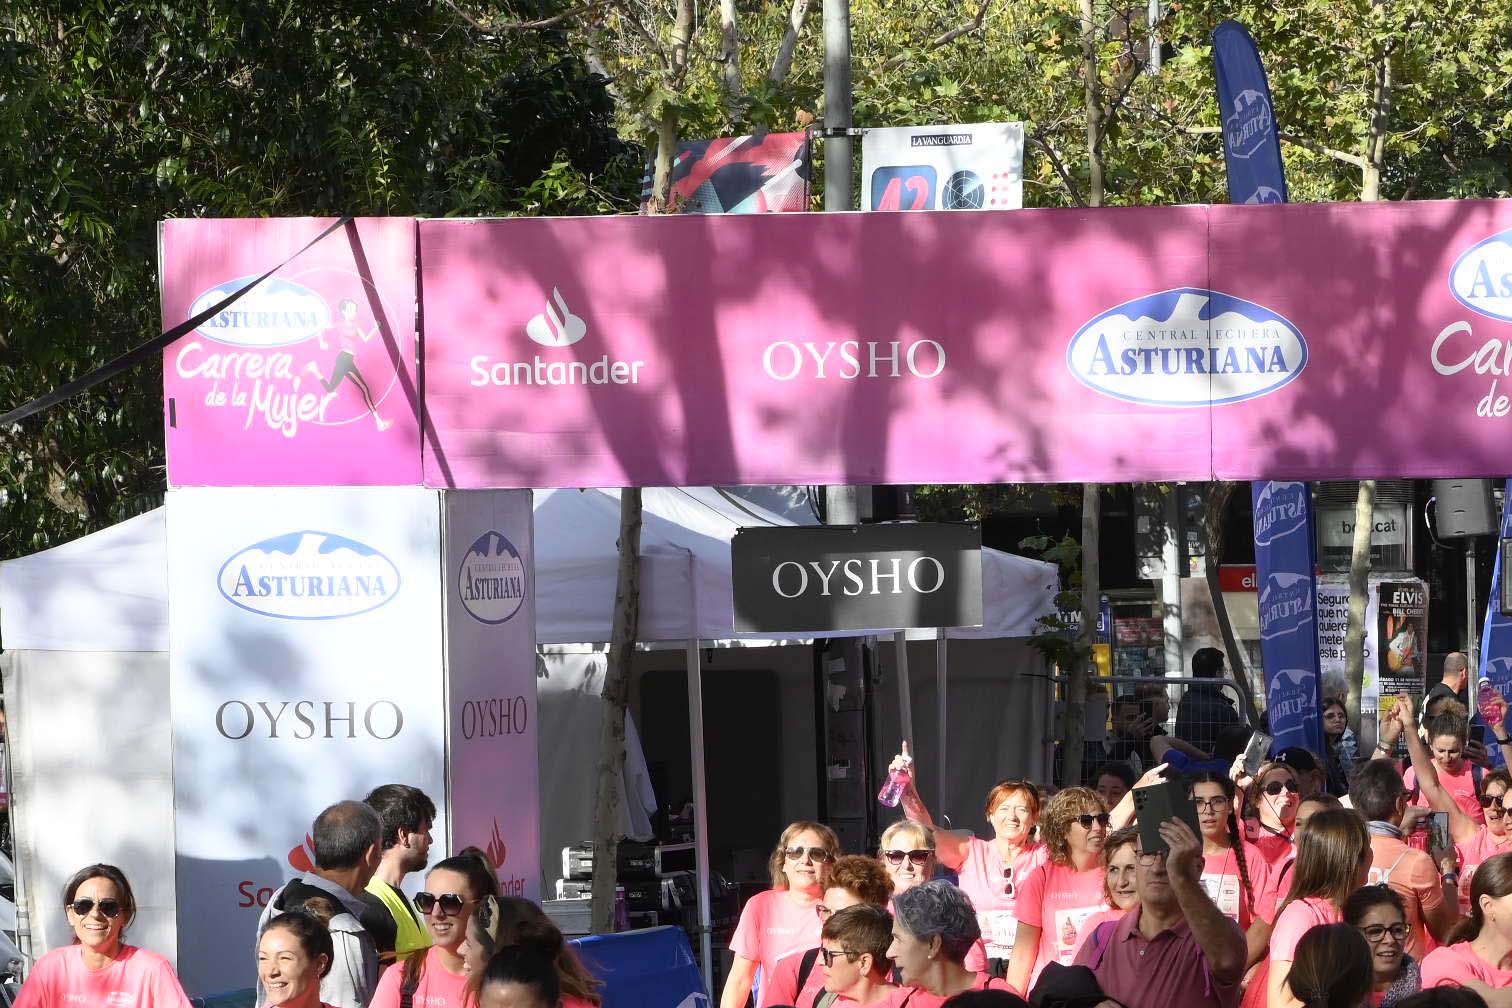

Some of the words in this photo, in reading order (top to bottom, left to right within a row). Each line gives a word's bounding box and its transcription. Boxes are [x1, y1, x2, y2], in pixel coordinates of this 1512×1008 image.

[923, 134, 972, 146] VANGUARDIA
[1123, 329, 1198, 341] CENTRAL
[1204, 329, 1281, 340] LECHERA
[175, 341, 294, 380] Carrera
[470, 354, 645, 386] Santander
[762, 339, 947, 381] OYSHO
[1088, 333, 1290, 376] ASTURIANA
[205, 383, 228, 407] de
[231, 380, 248, 407] la
[244, 375, 339, 439] Mujer
[1476, 378, 1511, 418] de
[231, 564, 387, 598] ASTURIANA
[464, 565, 522, 601] ASTURIANA
[772, 555, 946, 599] OYSHO
[1392, 591, 1424, 604] ELVIS
[1318, 621, 1350, 634] quiere
[1319, 646, 1338, 659] este
[214, 700, 404, 740] OYSHO
[461, 695, 528, 740] OYSHO
[238, 880, 272, 909] Sa
